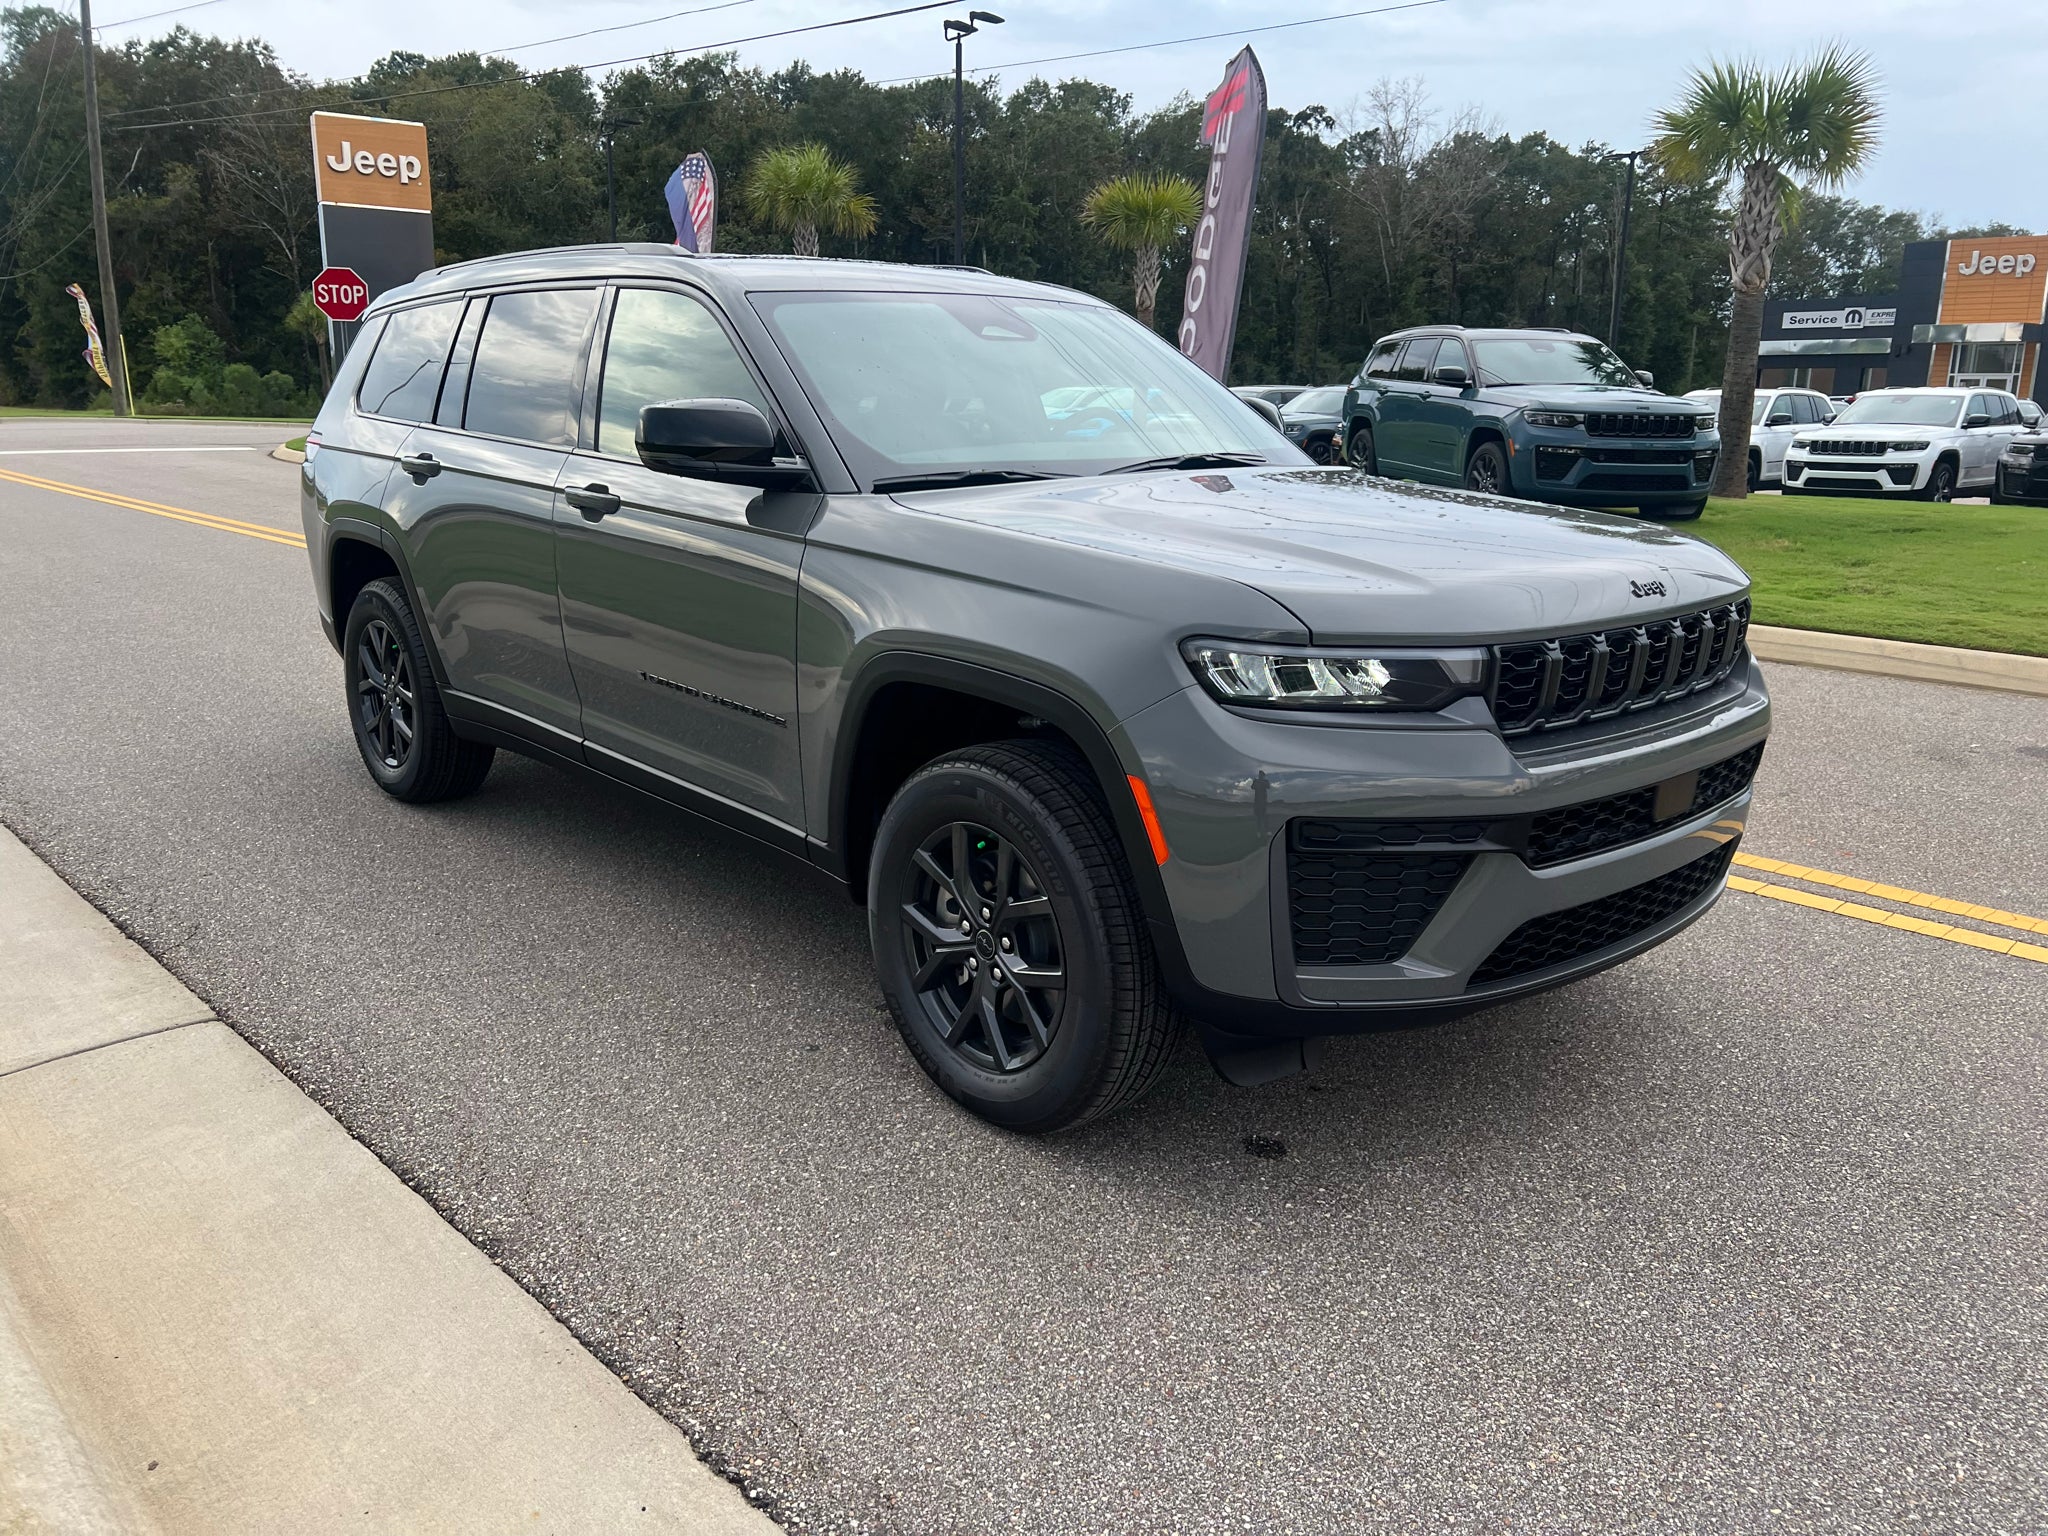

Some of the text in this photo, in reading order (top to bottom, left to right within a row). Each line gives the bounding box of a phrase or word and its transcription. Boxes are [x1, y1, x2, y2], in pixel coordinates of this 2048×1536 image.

[326, 140, 422, 184] Jeep
[1958, 250, 2036, 277] Jeep
[317, 283, 365, 305] STOP
[1789, 315, 1838, 325] Service
[1630, 580, 1667, 598] Jeep
